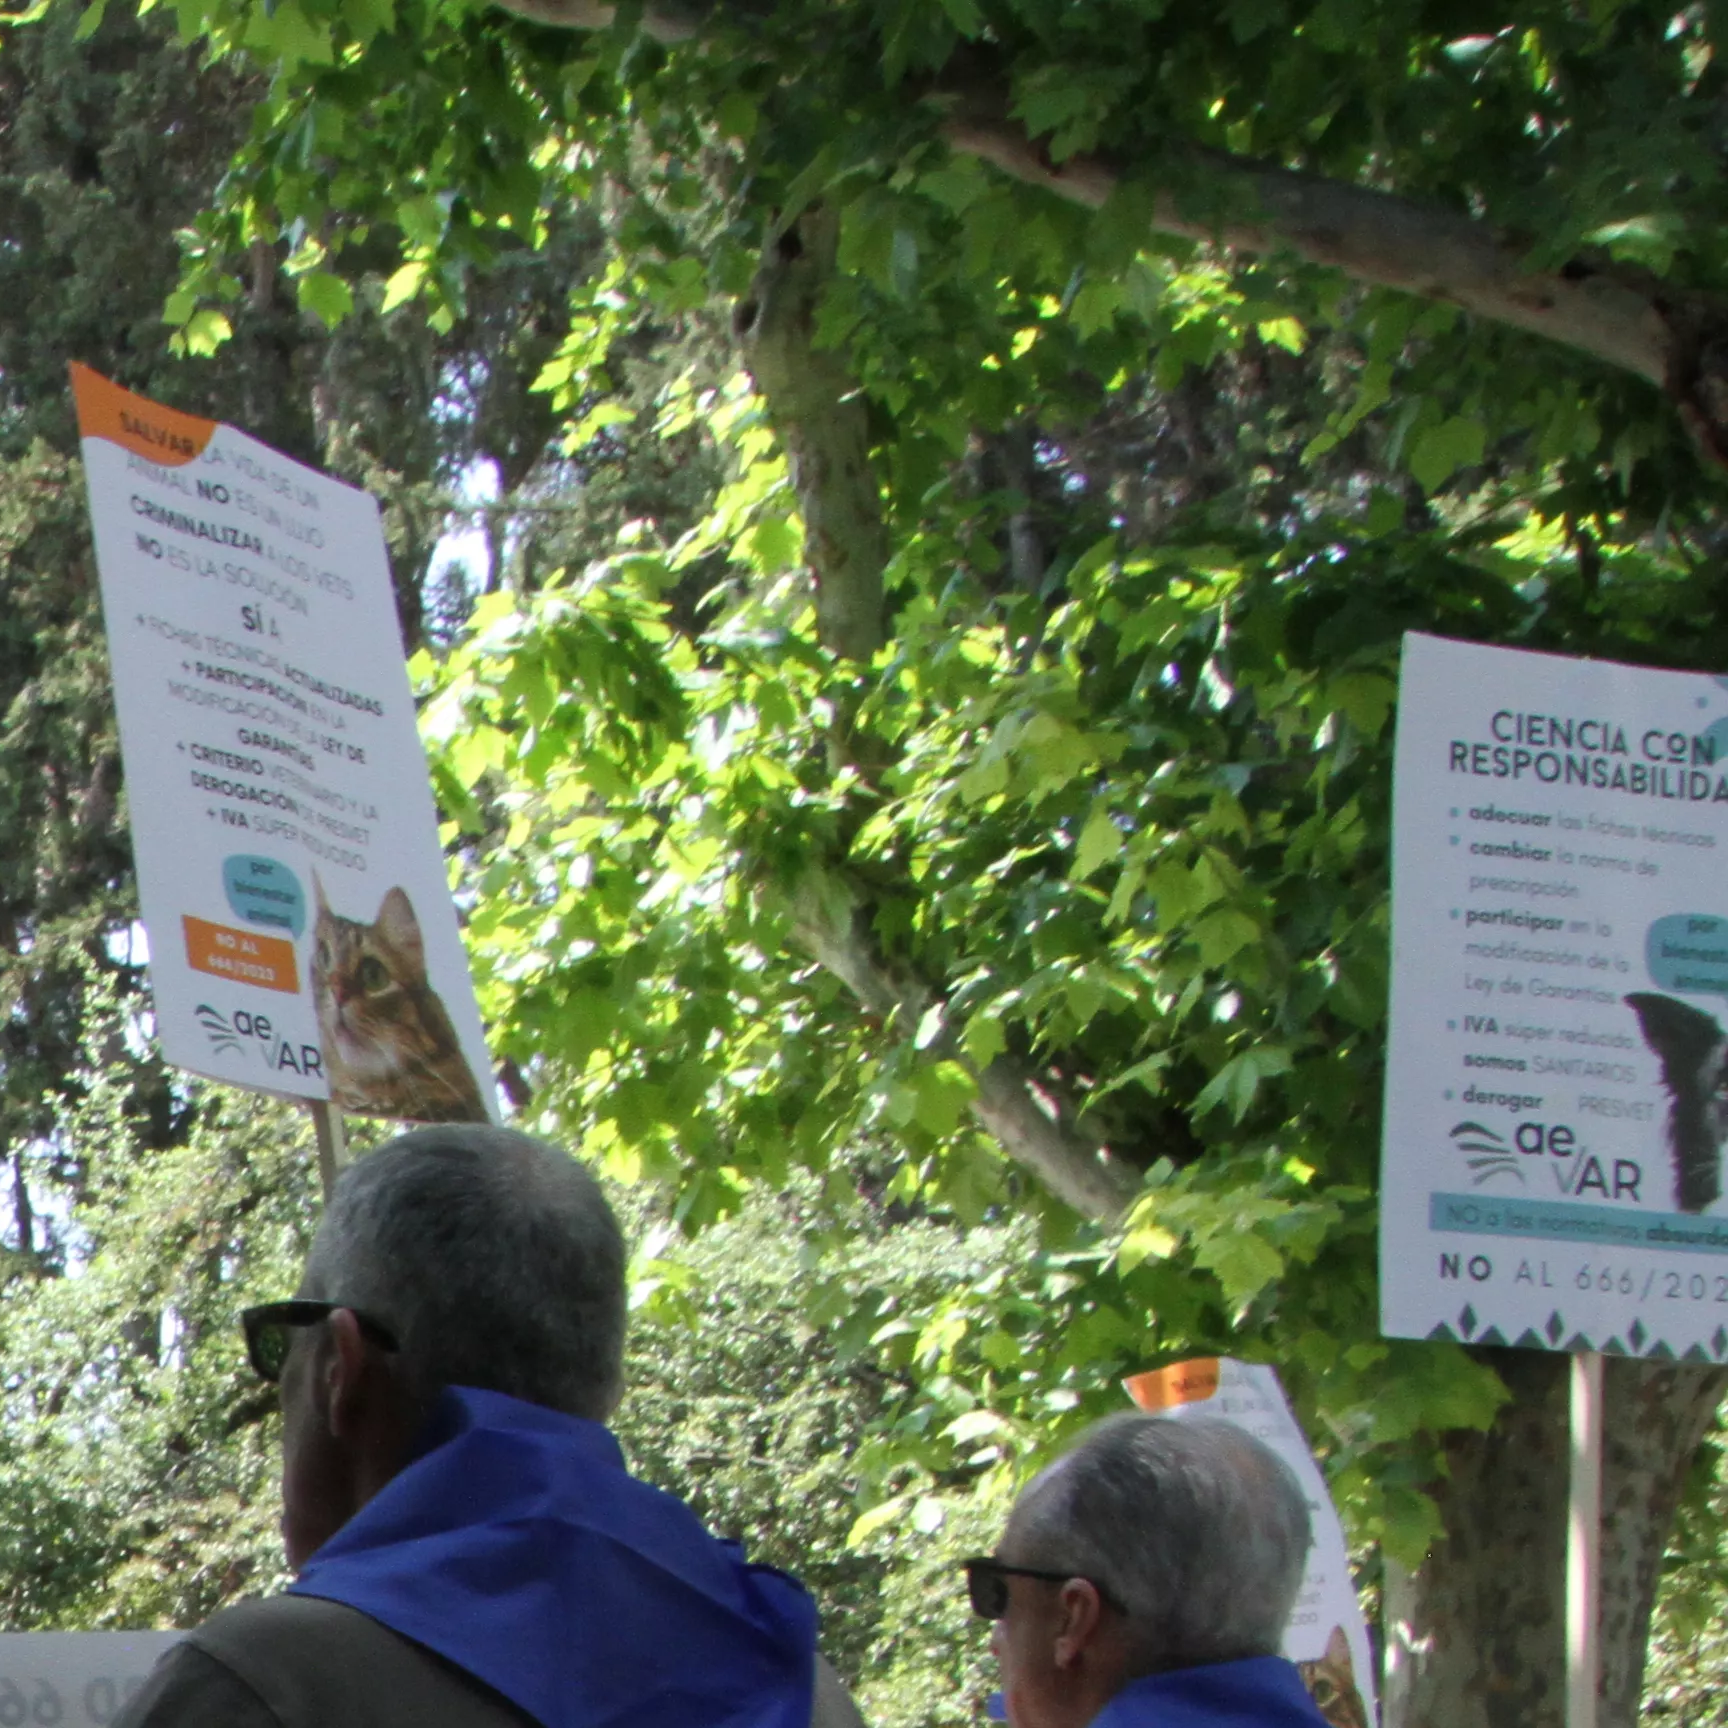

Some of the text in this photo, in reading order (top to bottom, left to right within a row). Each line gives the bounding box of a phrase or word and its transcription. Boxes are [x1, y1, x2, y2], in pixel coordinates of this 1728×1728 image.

[120, 410, 196, 457] SALVAR
[196, 478, 230, 504] NO
[130, 493, 263, 556] CRIMINALIZAR
[136, 532, 162, 560] NO
[167, 543, 191, 571] ES
[195, 552, 220, 579] LA
[241, 601, 264, 634] SÍ
[283, 662, 384, 718] ACTUALIZADAS
[1491, 709, 1629, 756] CIENCIA
[189, 742, 264, 777] CRITERIO
[320, 734, 344, 757] LEY
[346, 742, 366, 766] DE
[1448, 739, 1728, 803] RESPONSABILIDA
[221, 808, 249, 829] IVA
[1469, 803, 1553, 827] adecuar
[1557, 810, 1583, 831] las
[1587, 812, 1638, 839] fichas
[1469, 839, 1659, 877] cambiar la norma de
[1469, 875, 1580, 899] prescripción
[1465, 908, 1564, 935] participar
[1595, 917, 1613, 938] la
[1465, 940, 1630, 974] modificación de la
[1465, 973, 1494, 996] Ley
[1499, 974, 1523, 995] de
[1463, 1015, 1499, 1034] IVA
[1463, 1053, 1637, 1083] somos SANITARIOS
[1463, 1083, 1543, 1114] derogar
[1514, 1121, 1576, 1157] ae
[1447, 1203, 1480, 1225] NO
[1439, 1252, 1728, 1303] NO AL 666/202
